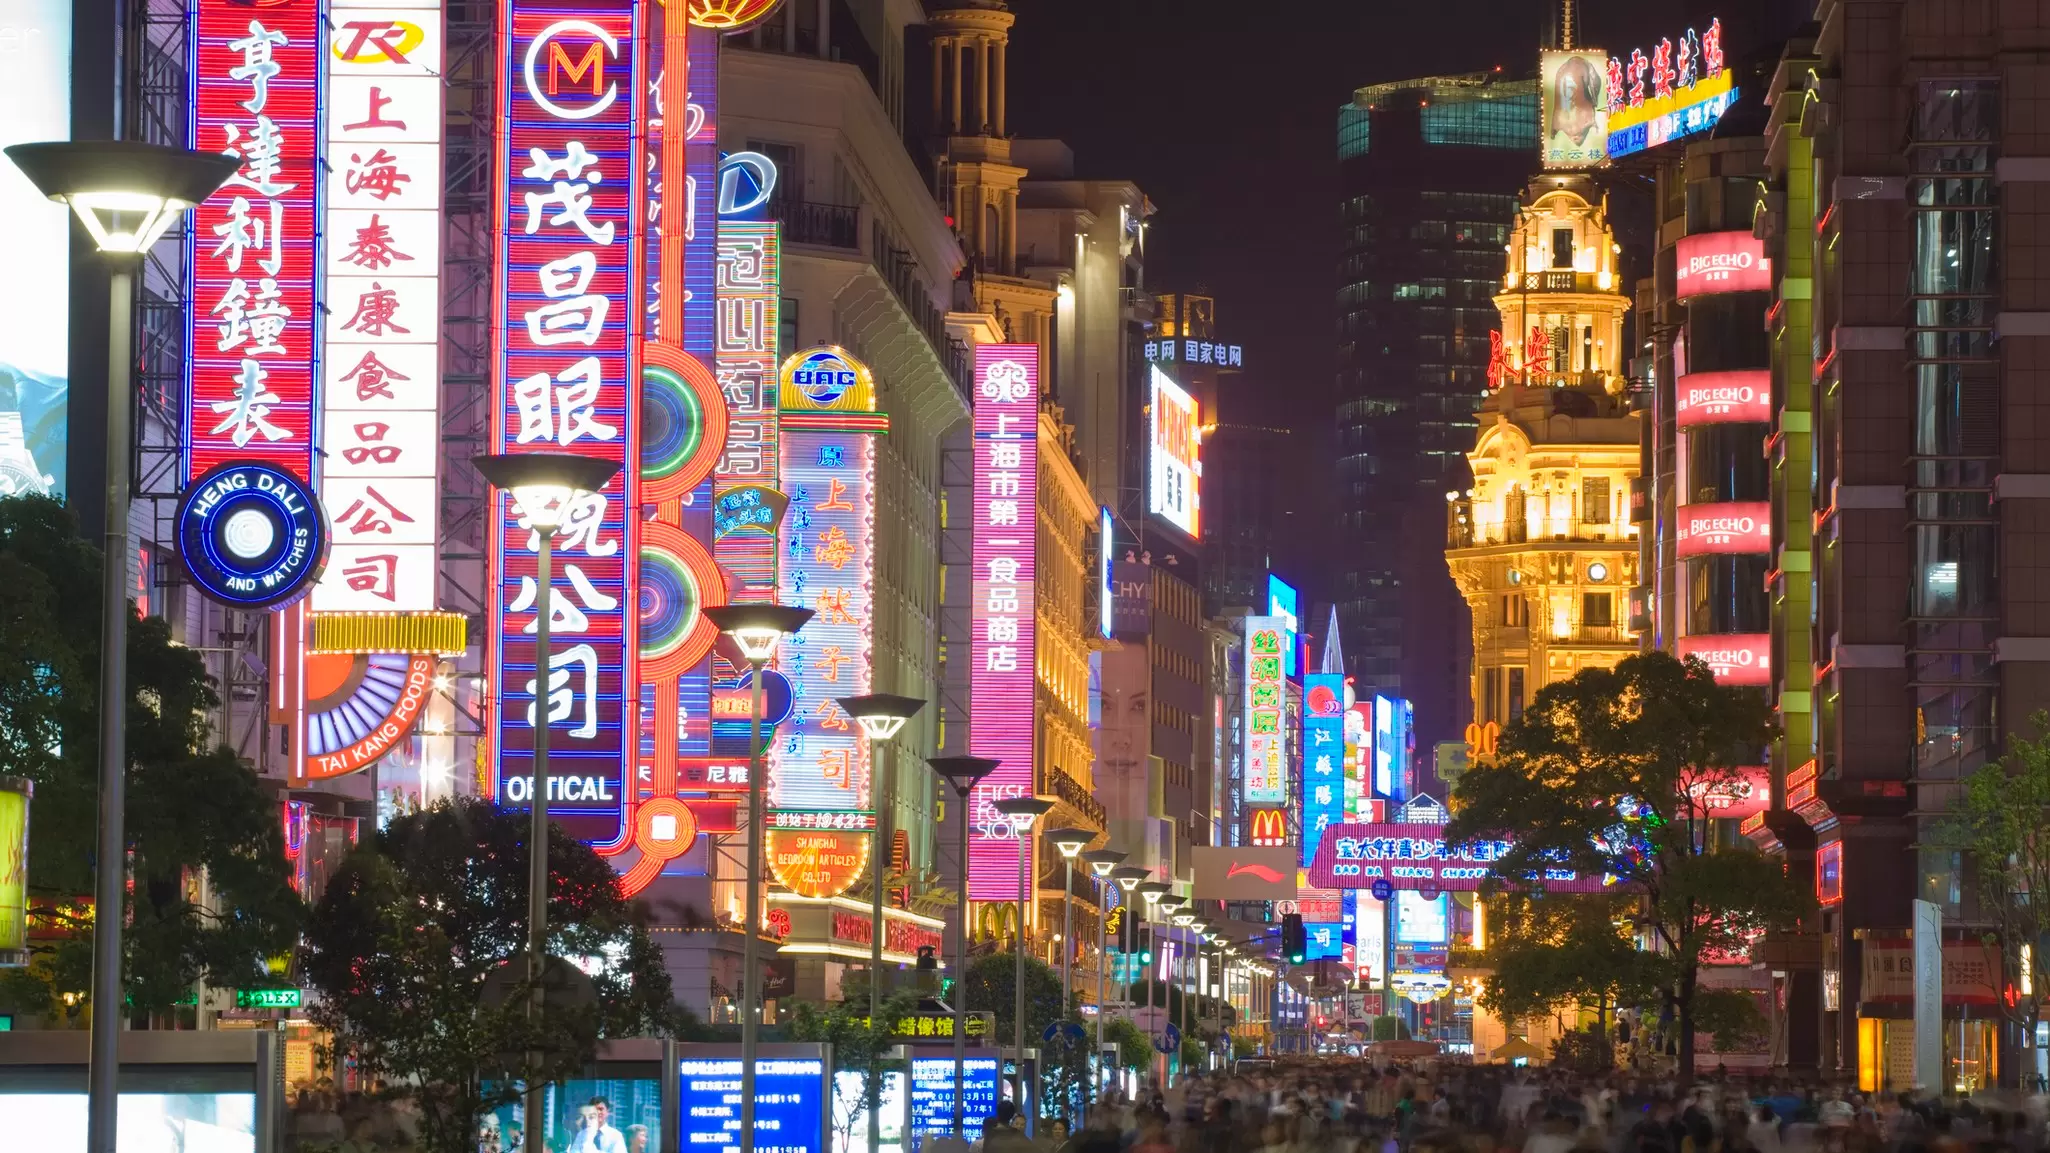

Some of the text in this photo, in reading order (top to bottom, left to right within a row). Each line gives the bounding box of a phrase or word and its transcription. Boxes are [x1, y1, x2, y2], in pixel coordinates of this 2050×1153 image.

[1690, 256, 1710, 274] BIG
[1712, 252, 1752, 268] ECHO
[334, 85, 415, 602] 上海泰康食品公司
[1185, 340, 1242, 367] 国家电网
[793, 370, 857, 386] BAC
[1690, 389, 1710, 405] BIG
[1712, 386, 1753, 401] ECHO
[193, 473, 305, 518] HENG DALI
[1691, 519, 1711, 536] BIG
[1713, 517, 1754, 532] ECHO
[986, 412, 1022, 672] 上海市第一食品商店
[226, 576, 256, 591] AND
[261, 527, 308, 588] WATCHES
[1712, 648, 1752, 664] ECHO
[318, 660, 428, 773] TAI KANG FOODS
[796, 837, 837, 849] SHANGHAI
[819, 854, 857, 867] ARTICLES
[1391, 867, 1433, 879] XIANG
[1313, 928, 1331, 947] 司
[1359, 949, 1381, 964] City
